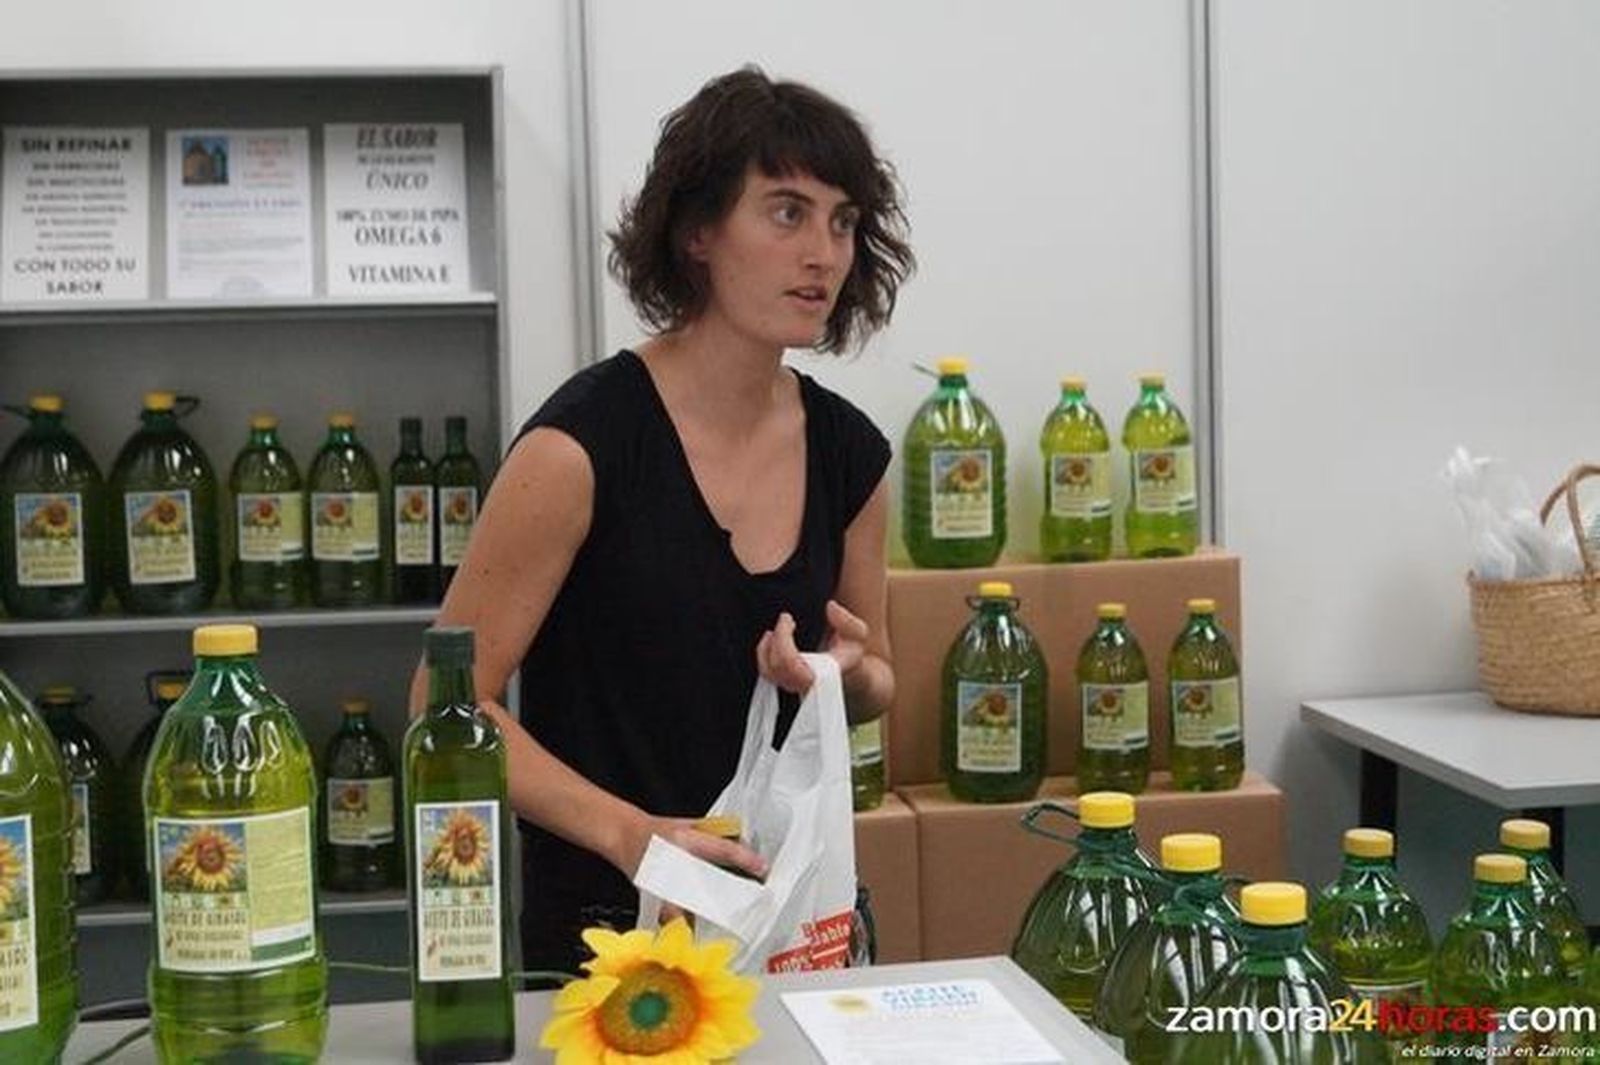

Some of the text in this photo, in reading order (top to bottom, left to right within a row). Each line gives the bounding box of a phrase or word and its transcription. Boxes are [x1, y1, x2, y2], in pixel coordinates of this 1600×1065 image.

[21, 137, 131, 151] SIN REFINAR
[382, 127, 438, 149] SABOR
[365, 169, 430, 190] ÚNICO
[355, 225, 443, 246] OMEGA 6
[14, 258, 137, 273] CON TODO SU
[348, 264, 451, 283] VITAMINA E
[46, 280, 104, 296] SABOR
